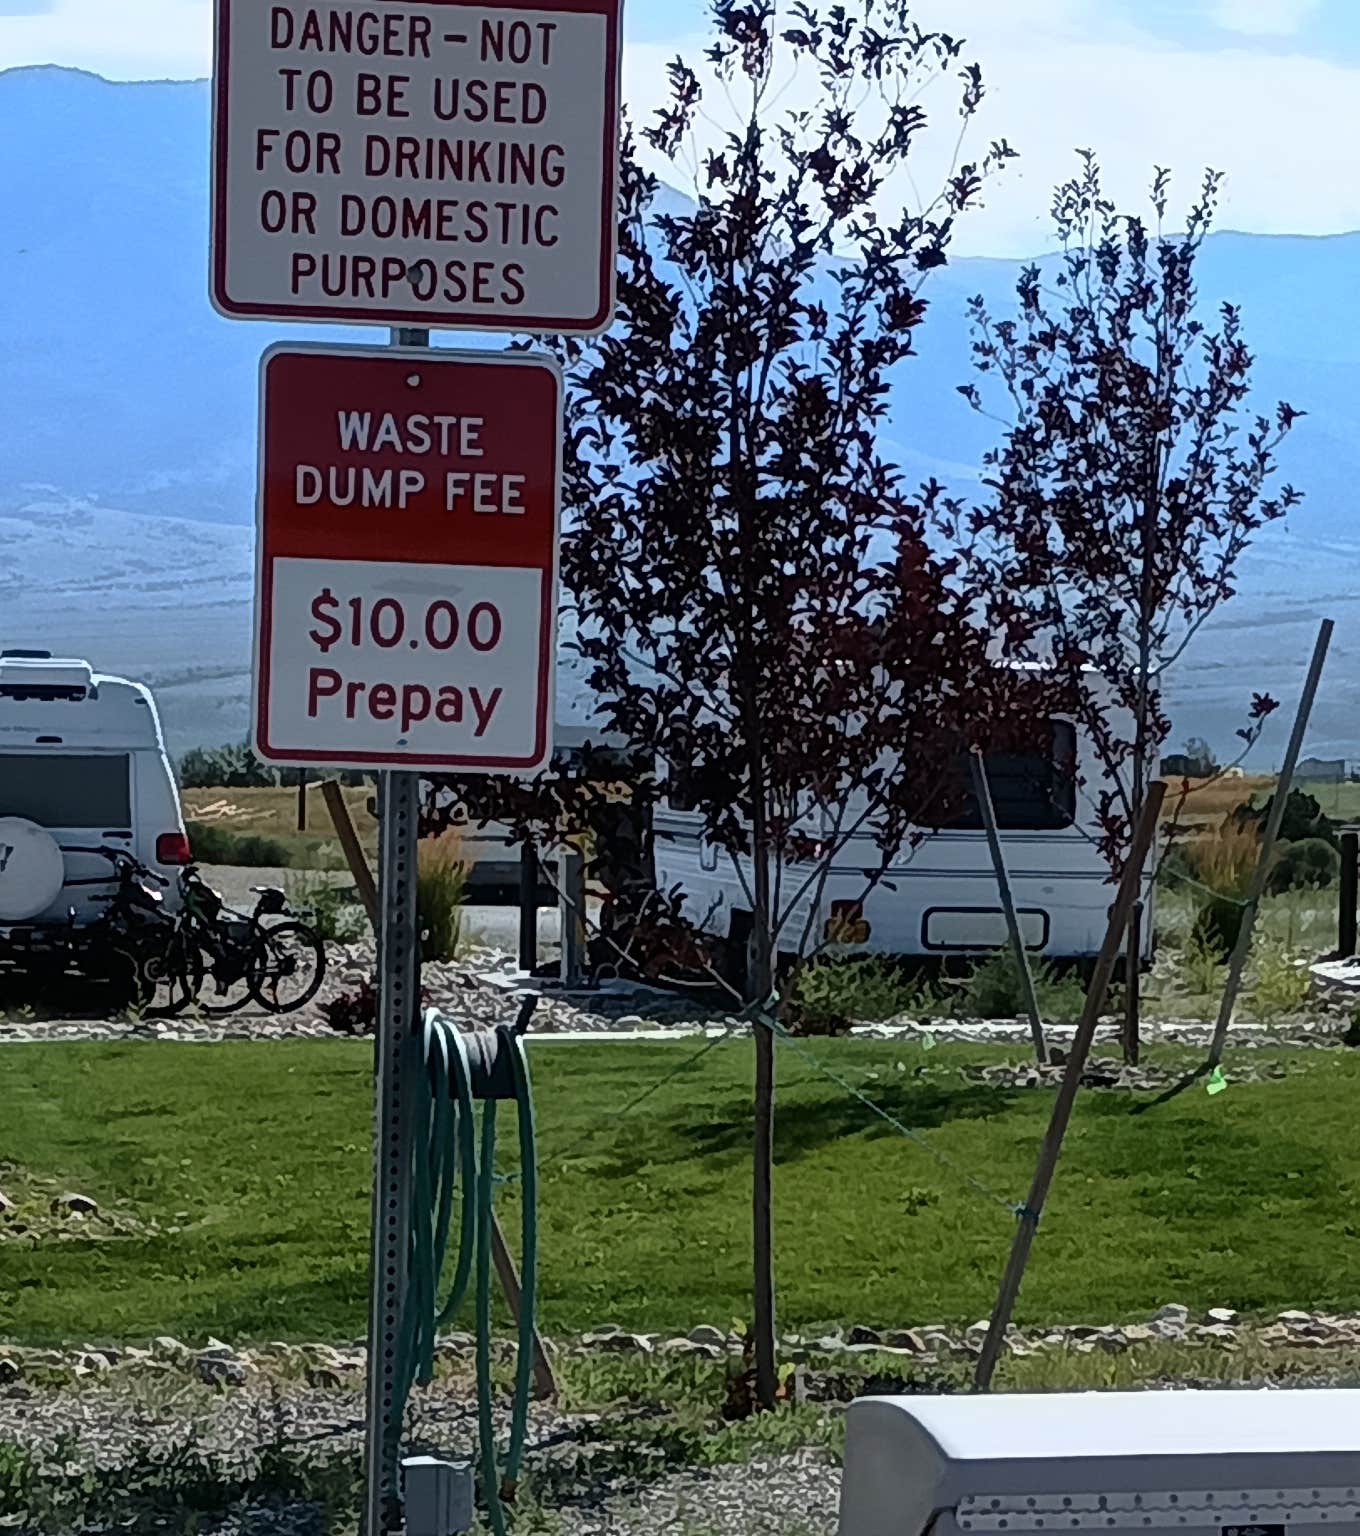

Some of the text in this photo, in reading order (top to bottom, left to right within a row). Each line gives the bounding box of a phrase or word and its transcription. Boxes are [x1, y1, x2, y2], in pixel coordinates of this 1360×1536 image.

[278, 69, 547, 125] TO BE USED
[256, 129, 565, 188] FOR DRINKING
[260, 190, 559, 247] OR DOMESTIC
[291, 253, 525, 305] PURPOSES
[338, 410, 484, 456] WASTE
[296, 465, 526, 514] DUMP FEE
[309, 588, 502, 653] $10.00
[308, 668, 503, 737] Prepay
